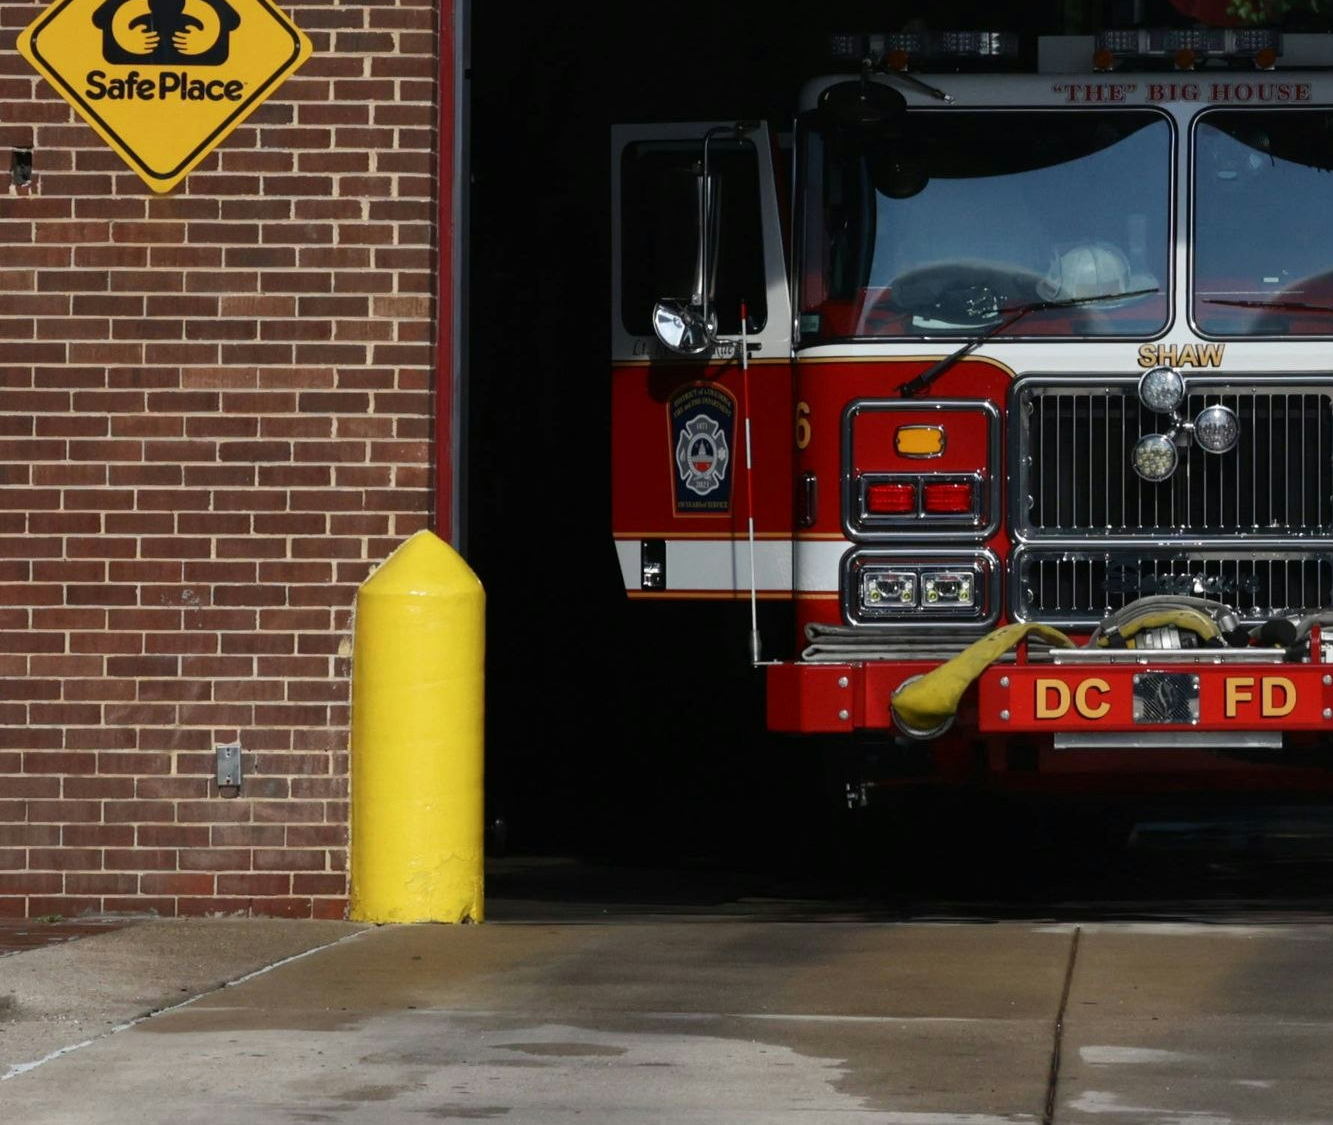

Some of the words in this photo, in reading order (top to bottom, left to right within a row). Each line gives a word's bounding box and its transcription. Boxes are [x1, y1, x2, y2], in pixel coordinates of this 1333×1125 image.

[1145, 83, 1200, 102] BIG
[1210, 82, 1312, 101] HOUSE
[1137, 343, 1226, 369] SHAW
[796, 401, 812, 450] 6
[1034, 678, 1111, 719] DC
[1225, 676, 1297, 717] FD
